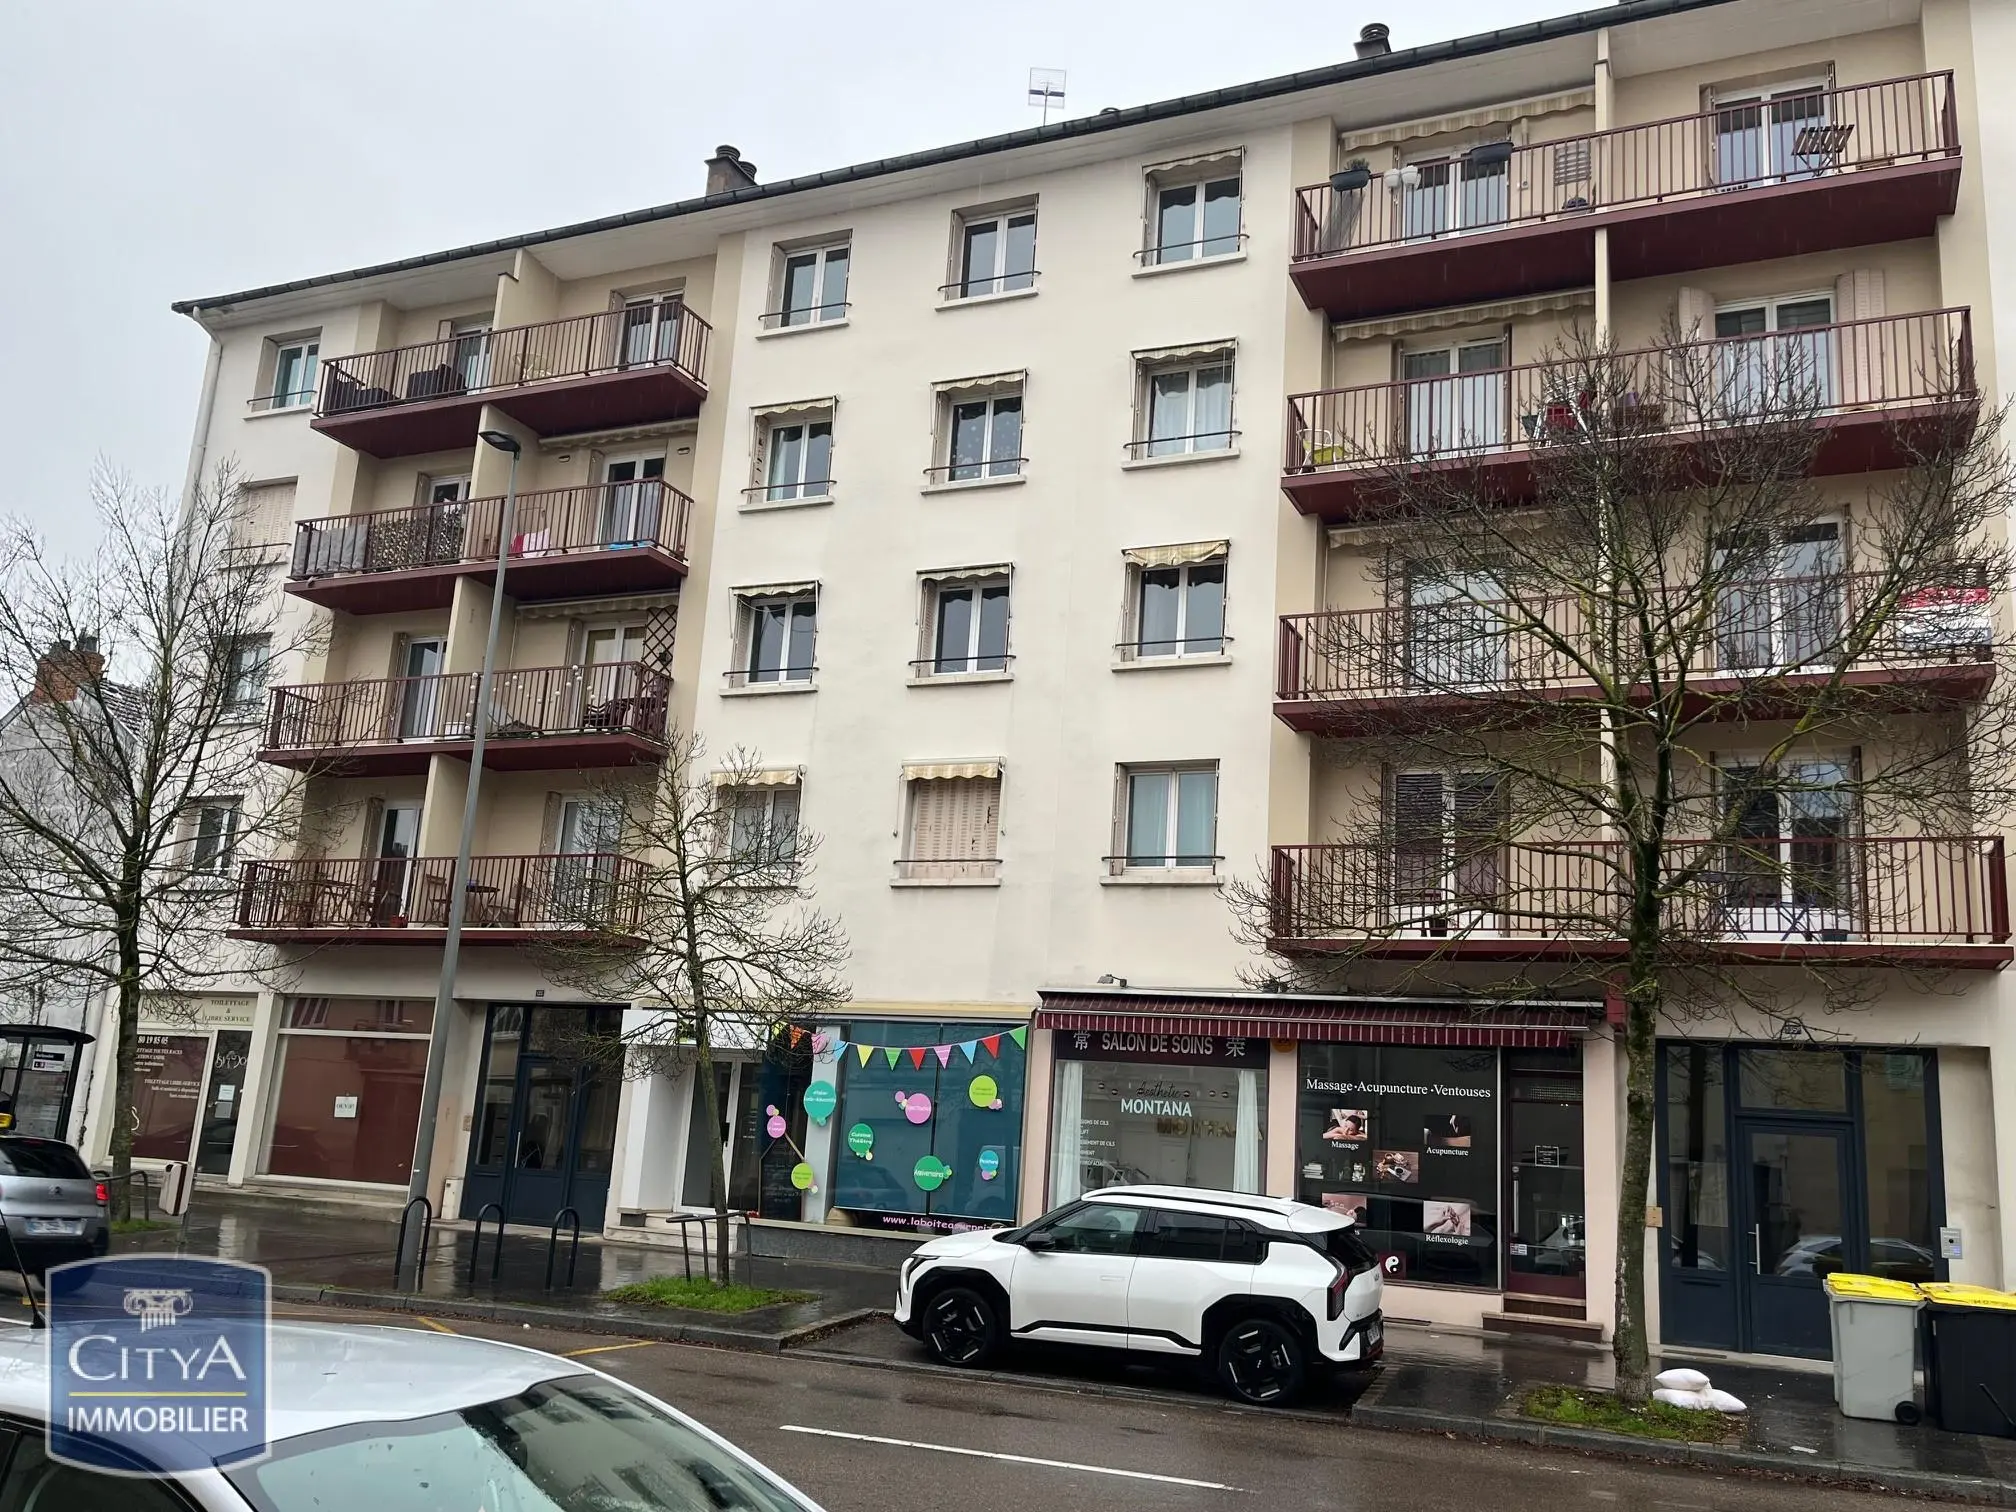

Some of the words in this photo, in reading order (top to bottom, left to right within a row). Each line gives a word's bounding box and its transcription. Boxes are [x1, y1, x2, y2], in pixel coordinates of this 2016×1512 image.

[1101, 1032, 1147, 1052] SALON
[1150, 1035, 1168, 1053] DE
[1171, 1035, 1213, 1055] SOINS
[1306, 1078, 1353, 1094] Massage
[1121, 1098, 1192, 1117] MONTANA
[1331, 1141, 1359, 1150] Massage
[1426, 1146, 1469, 1156] Acupuncture
[1425, 1234, 1469, 1245] Réflexologie
